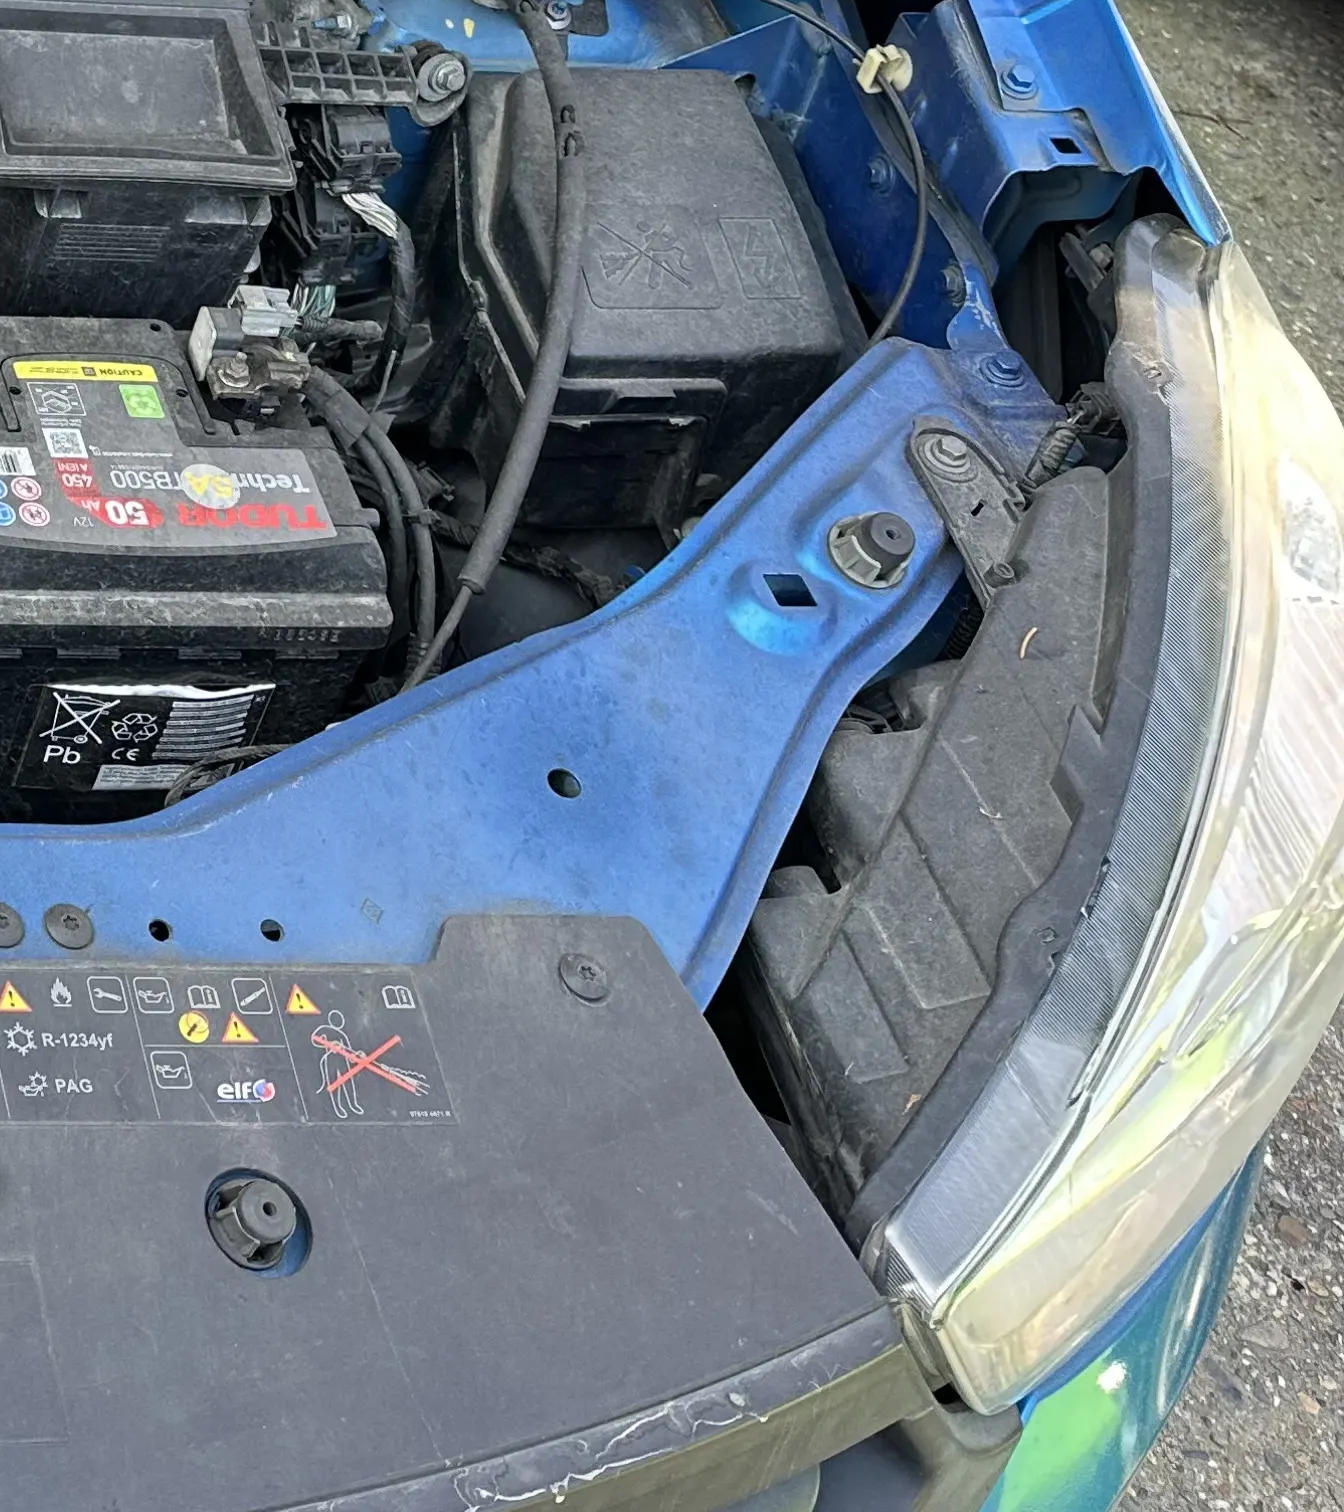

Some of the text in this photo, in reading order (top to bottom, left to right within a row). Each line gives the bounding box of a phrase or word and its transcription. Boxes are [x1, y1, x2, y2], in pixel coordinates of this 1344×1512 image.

[99, 367, 144, 377] CAUTION
[79, 462, 88, 471] A
[61, 474, 93, 488] 450
[109, 470, 310, 494] Techn TB500
[73, 515, 95, 529] 12V
[82, 498, 151, 527] 50 Ah
[177, 502, 327, 532] TUDOR
[43, 744, 81, 764] Pb
[41, 1031, 113, 1051] R-1234yf
[55, 1078, 93, 1094] PAG
[217, 1081, 254, 1100] elf
